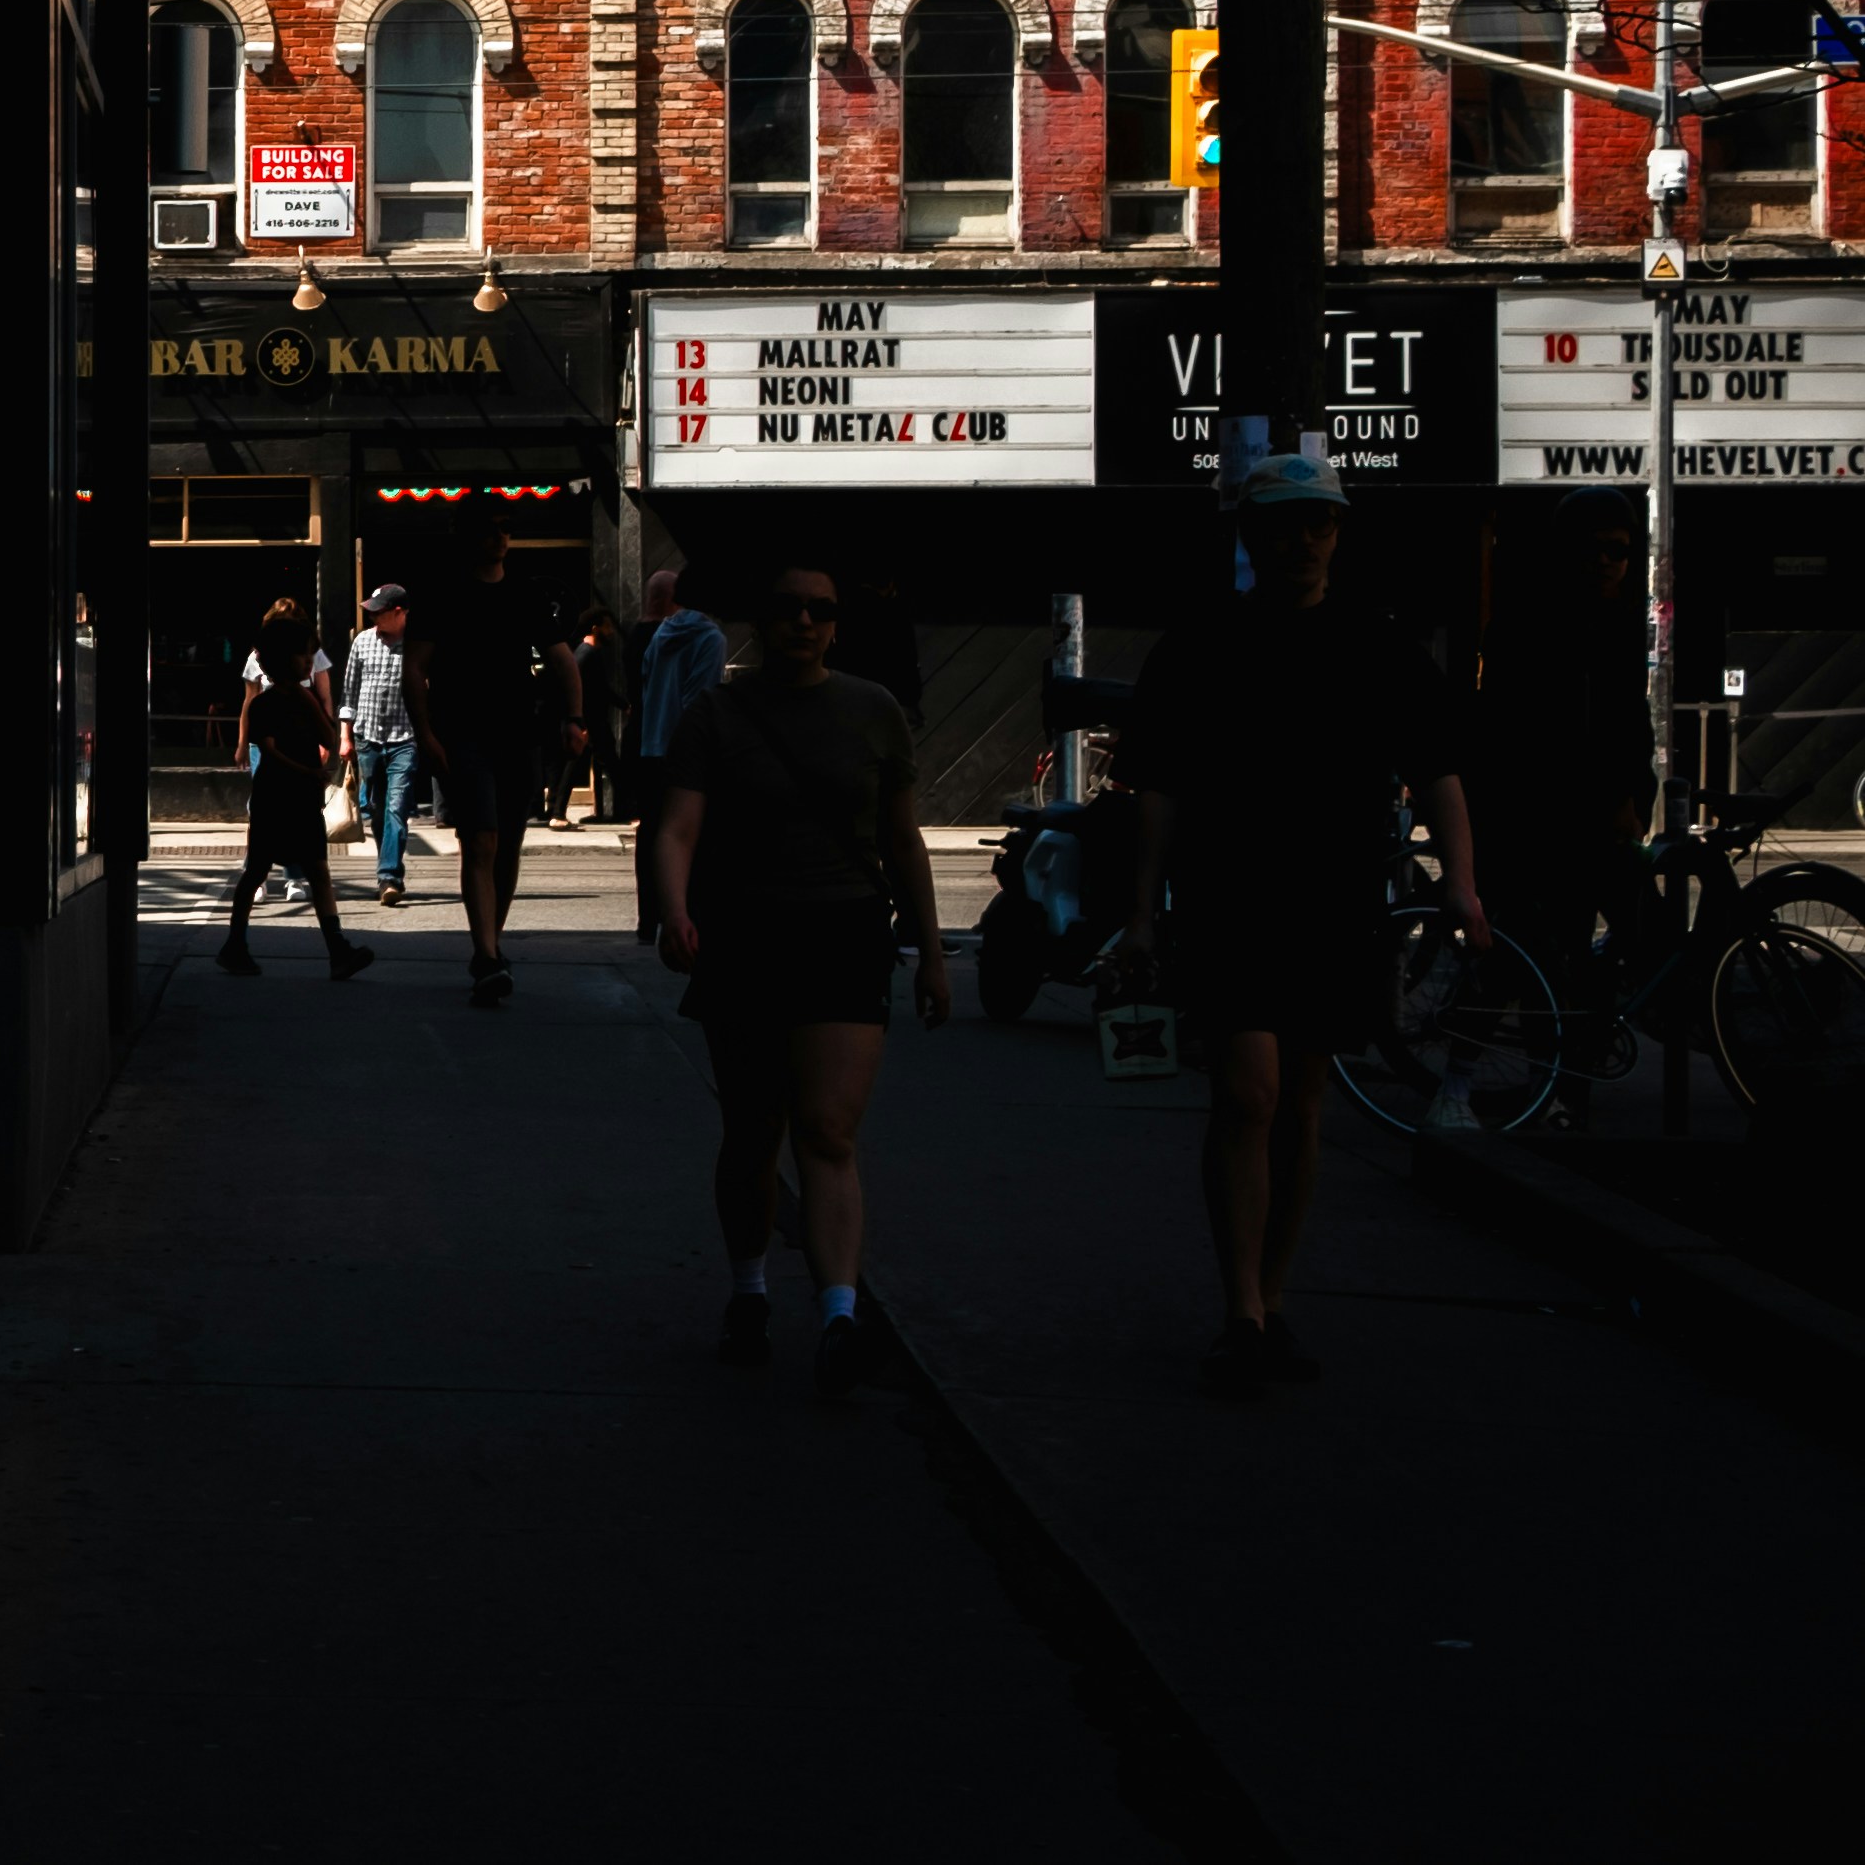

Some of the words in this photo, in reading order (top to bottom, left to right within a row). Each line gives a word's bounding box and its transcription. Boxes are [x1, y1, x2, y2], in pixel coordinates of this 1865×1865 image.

[260, 149, 345, 164] BUILDING
[262, 165, 297, 180] FOR
[302, 165, 345, 180] SALE
[284, 201, 321, 211] DAVE
[817, 302, 885, 332] MAY
[1673, 295, 1750, 325] MAY
[149, 338, 247, 376] BAR
[326, 335, 501, 374] KARMA
[675, 340, 706, 369] 13
[757, 339, 899, 369] MALLRAT
[1544, 333, 1578, 363] 10
[1167, 331, 1424, 396] VET
[676, 377, 708, 406] 14
[758, 376, 851, 406] NEONI
[1631, 370, 1710, 401] SLD
[1725, 370, 1788, 401] OUT
[678, 413, 708, 443] 17
[758, 412, 799, 443] NU
[812, 412, 915, 443] METAL
[931, 412, 1007, 443] CLUB
[1172, 414, 1420, 441] UNOUND
[1352, 451, 1400, 469] West
[1543, 445, 1865, 476] WWWHEVELVET.C
